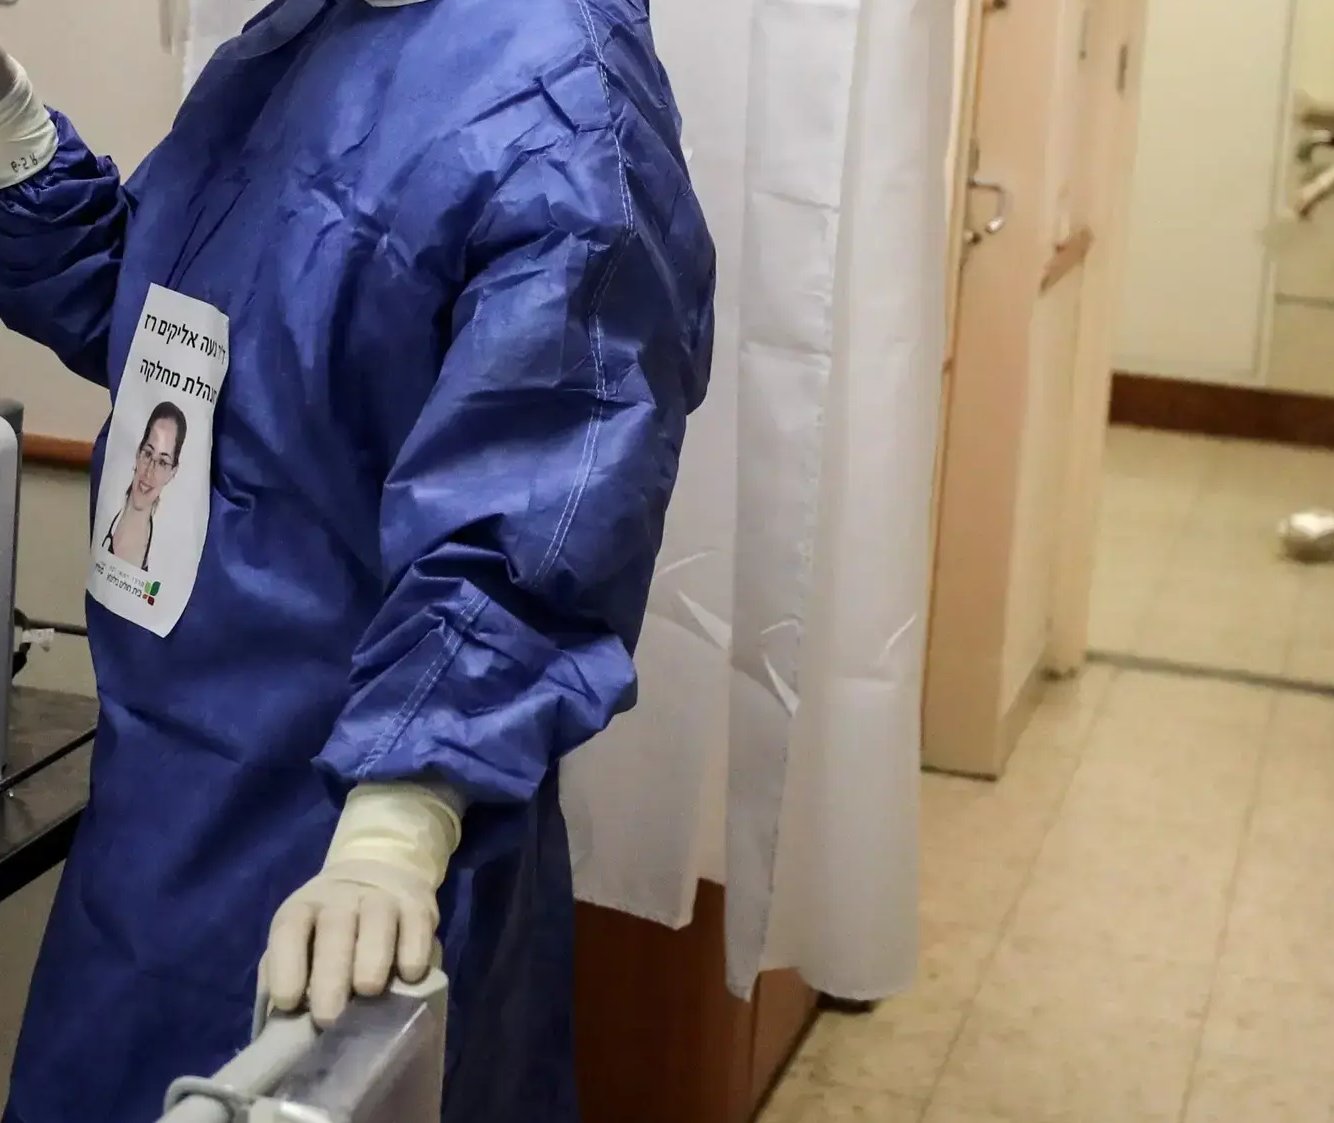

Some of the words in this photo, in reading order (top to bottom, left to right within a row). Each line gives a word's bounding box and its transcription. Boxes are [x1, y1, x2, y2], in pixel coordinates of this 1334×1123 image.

[144, 314, 157, 332] רז
[158, 320, 199, 349] אליקים
[140, 359, 181, 388] מחלקה
